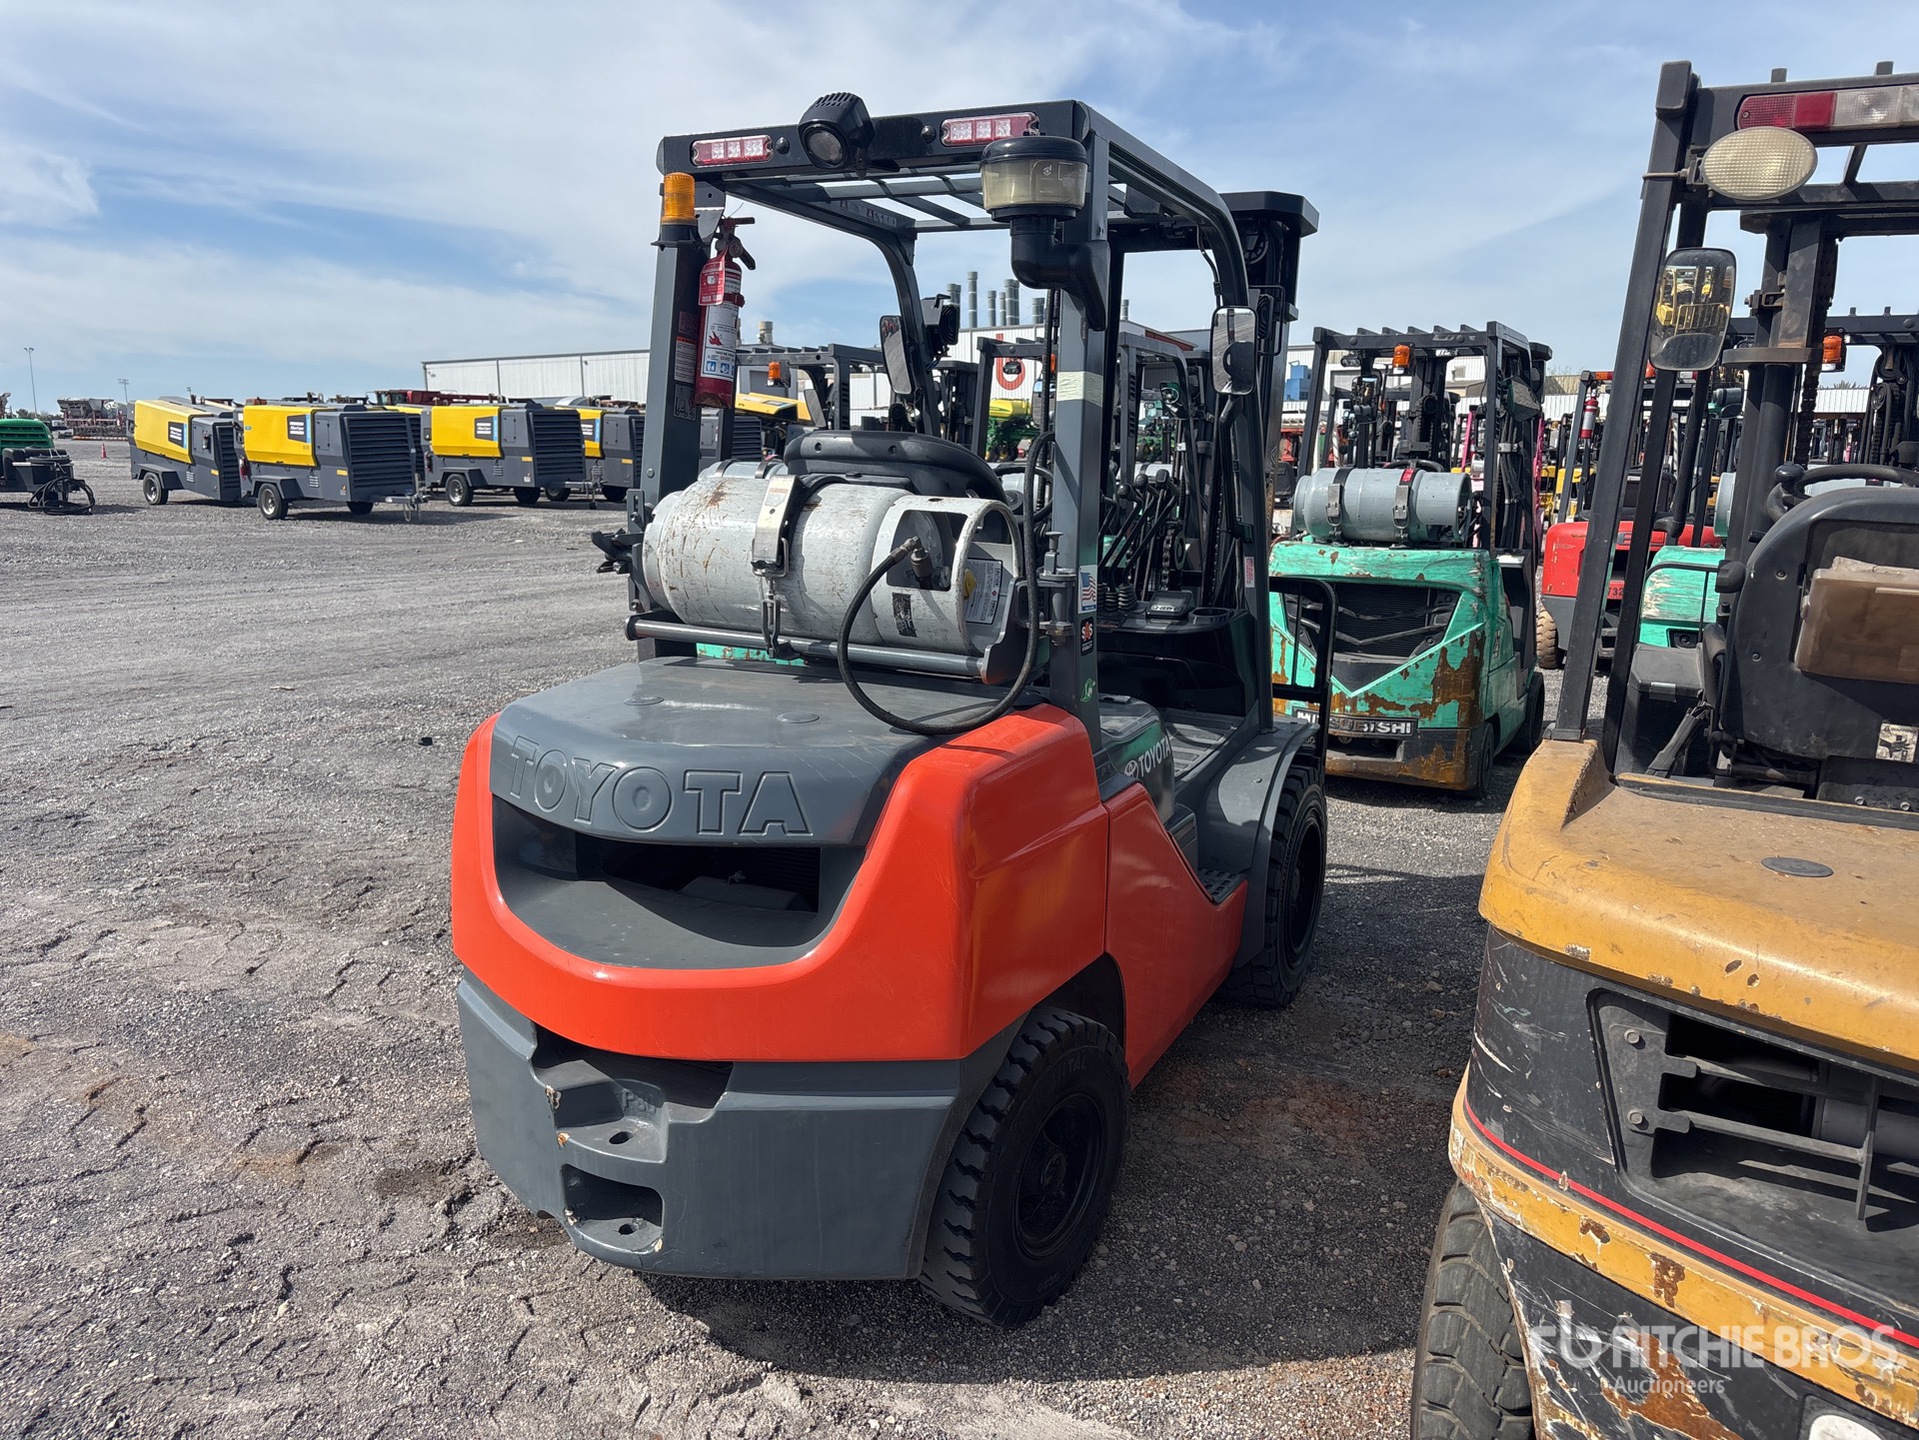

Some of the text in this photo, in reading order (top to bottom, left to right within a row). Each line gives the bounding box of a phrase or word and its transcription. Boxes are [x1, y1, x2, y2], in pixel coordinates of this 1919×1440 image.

[1297, 711, 1411, 734] MISUBISHI
[1138, 735, 1172, 777] TOYOTA
[510, 735, 814, 837] TOYOTA
